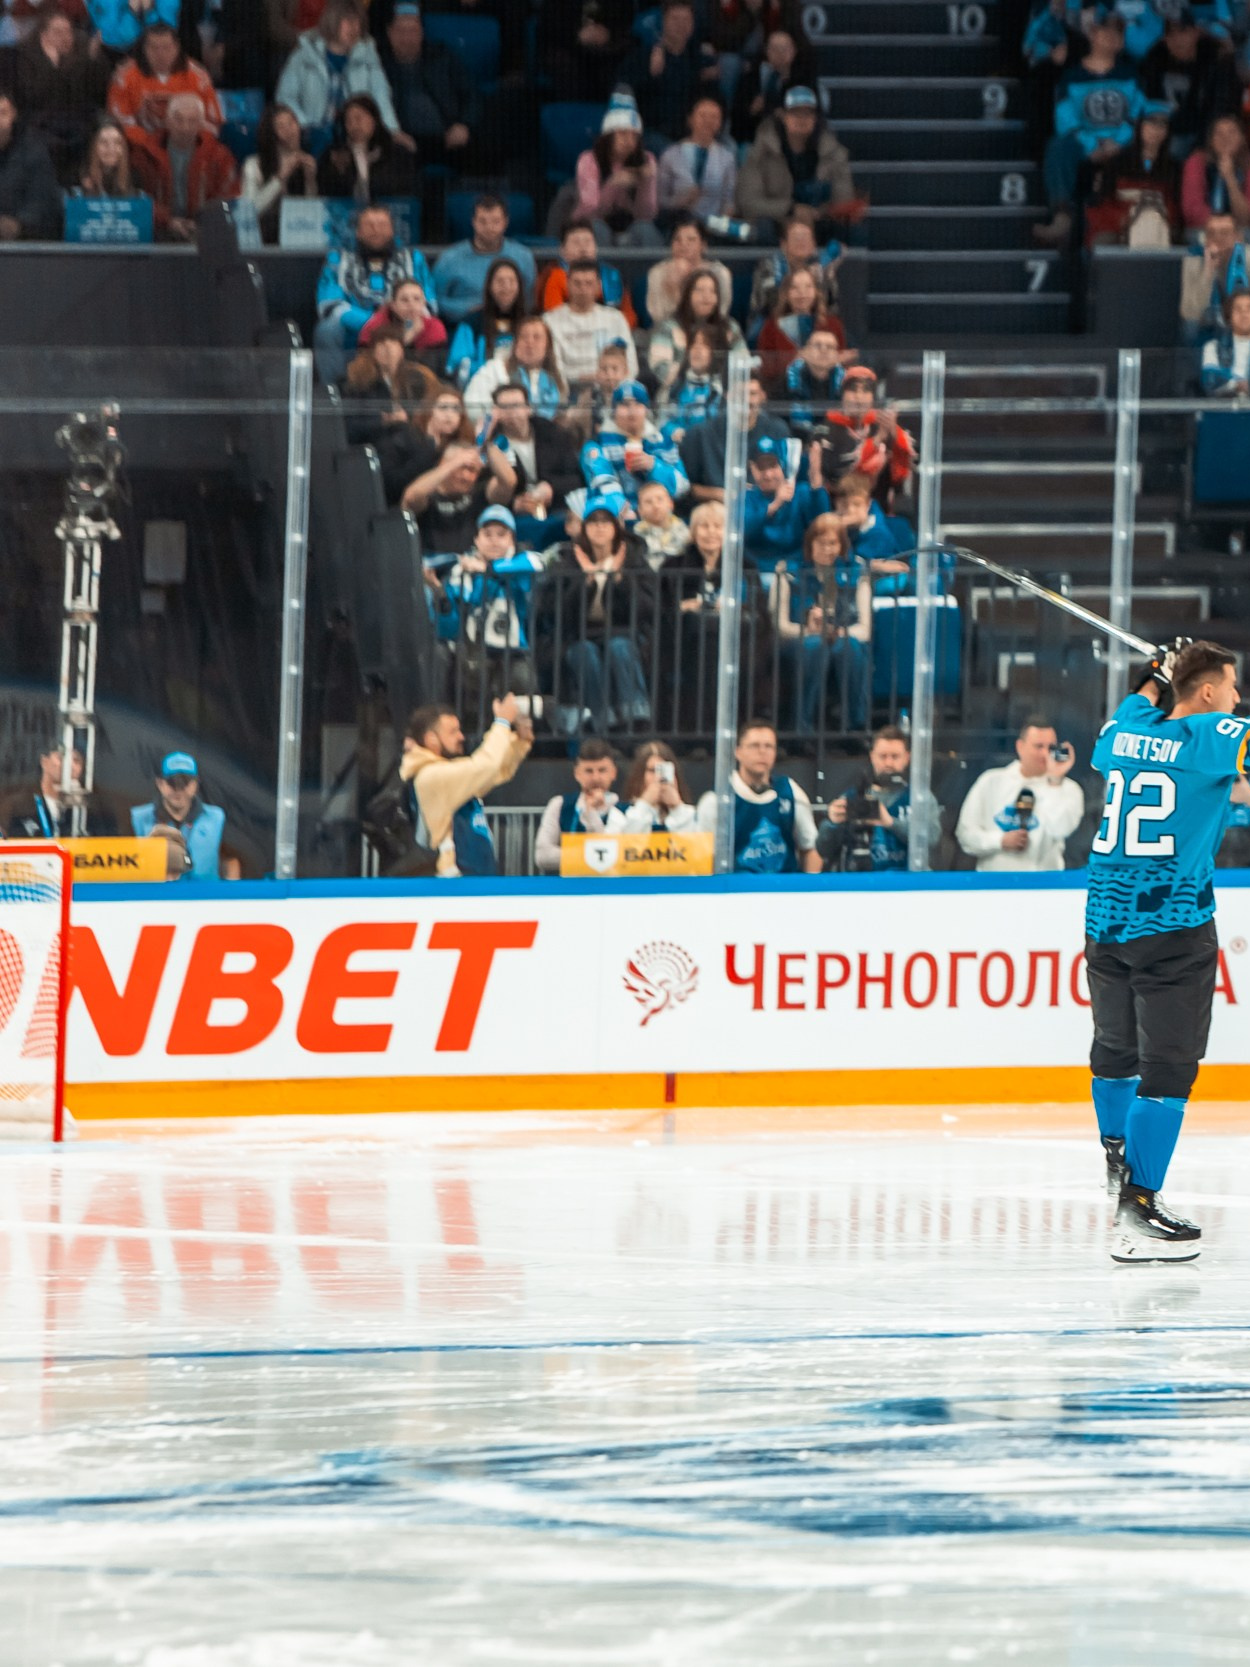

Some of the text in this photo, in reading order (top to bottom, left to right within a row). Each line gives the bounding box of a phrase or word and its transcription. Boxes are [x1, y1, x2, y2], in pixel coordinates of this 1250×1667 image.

[946, 5, 986, 36] 10
[982, 83, 1007, 118] 9
[1001, 173, 1026, 204] 8
[1026, 259, 1048, 292] 7
[1092, 769, 1176, 857] 92
[73, 853, 140, 869] БАНК
[0, 920, 539, 1057] NBET
[724, 943, 1239, 1010] ЧЕРНОГОЛОА
